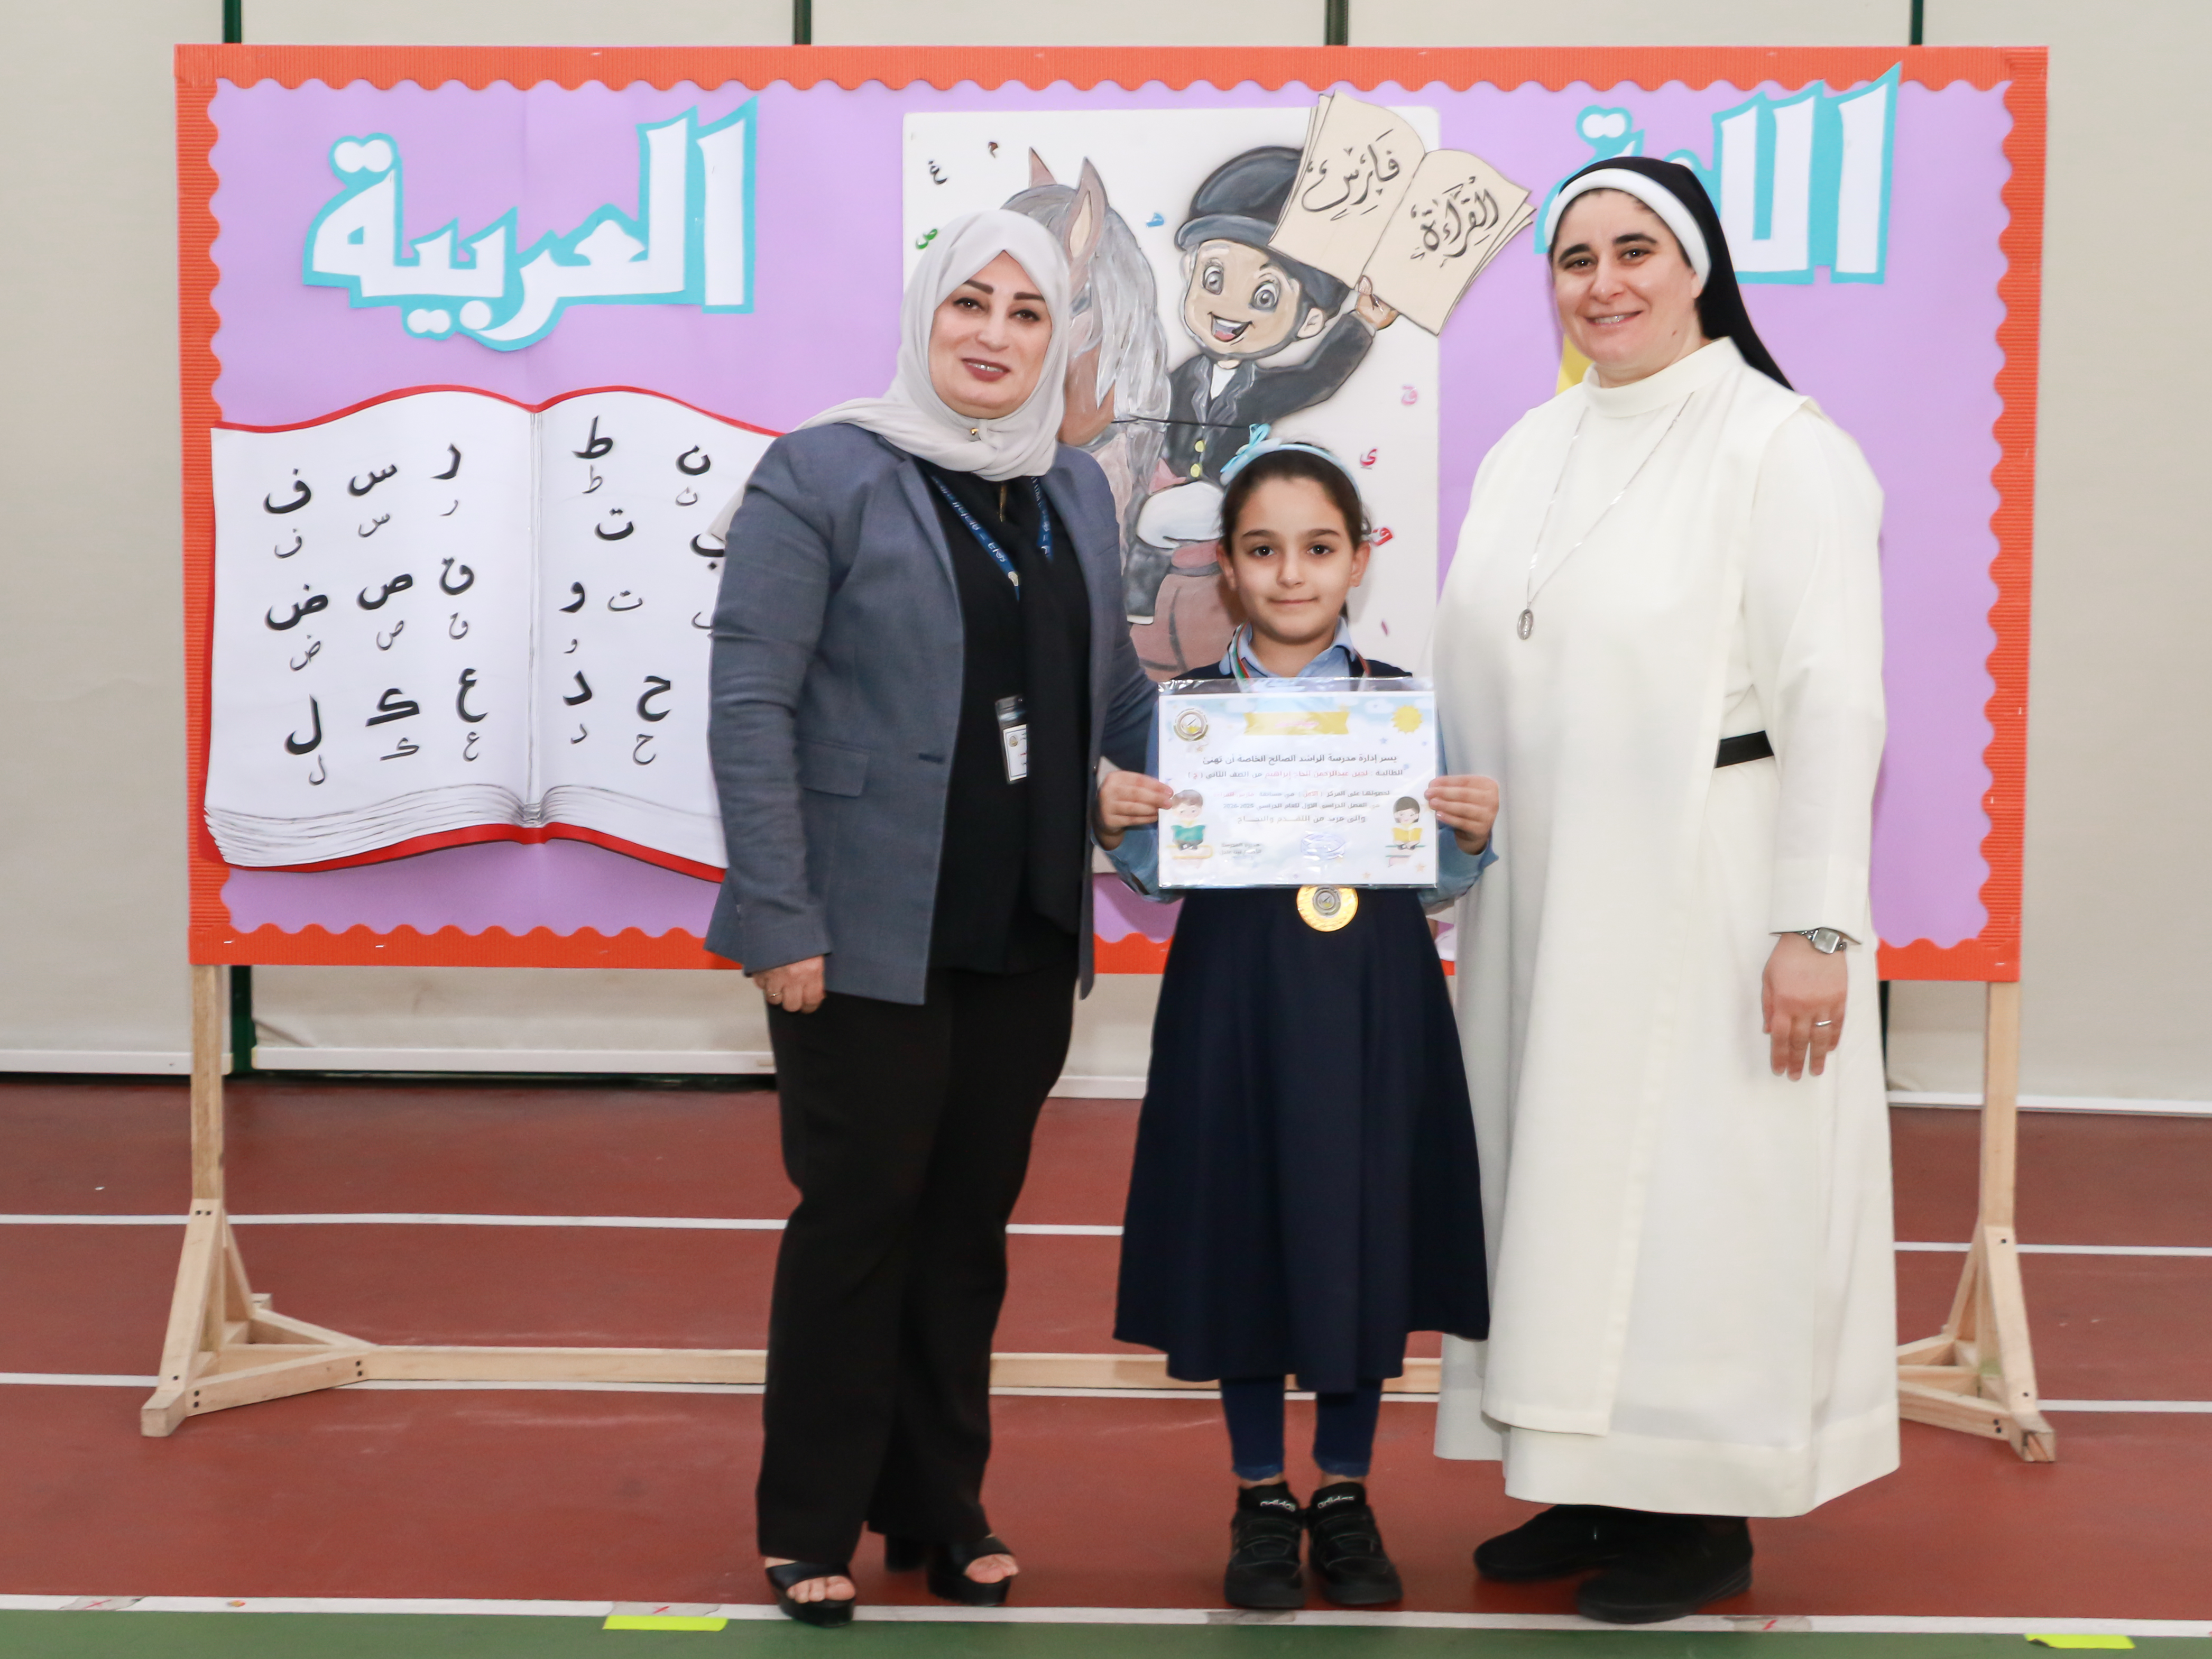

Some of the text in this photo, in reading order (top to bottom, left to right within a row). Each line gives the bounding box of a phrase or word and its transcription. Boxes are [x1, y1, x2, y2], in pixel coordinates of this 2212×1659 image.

[1535, 62, 1901, 284] الل
[303, 96, 758, 351] العربية
[573, 415, 712, 476] ن ط
[263, 443, 462, 515] ر س ف
[594, 508, 634, 542] ت
[264, 556, 475, 631] ق ص ض
[558, 580, 586, 614] و
[284, 667, 489, 756] ع ك ل
[635, 674, 672, 723] ح
[1237, 754, 1266, 763] الخاصة
[1268, 754, 1296, 766] الصالح
[1328, 753, 1357, 763] مدرسة
[1359, 753, 1377, 764] إدارة
